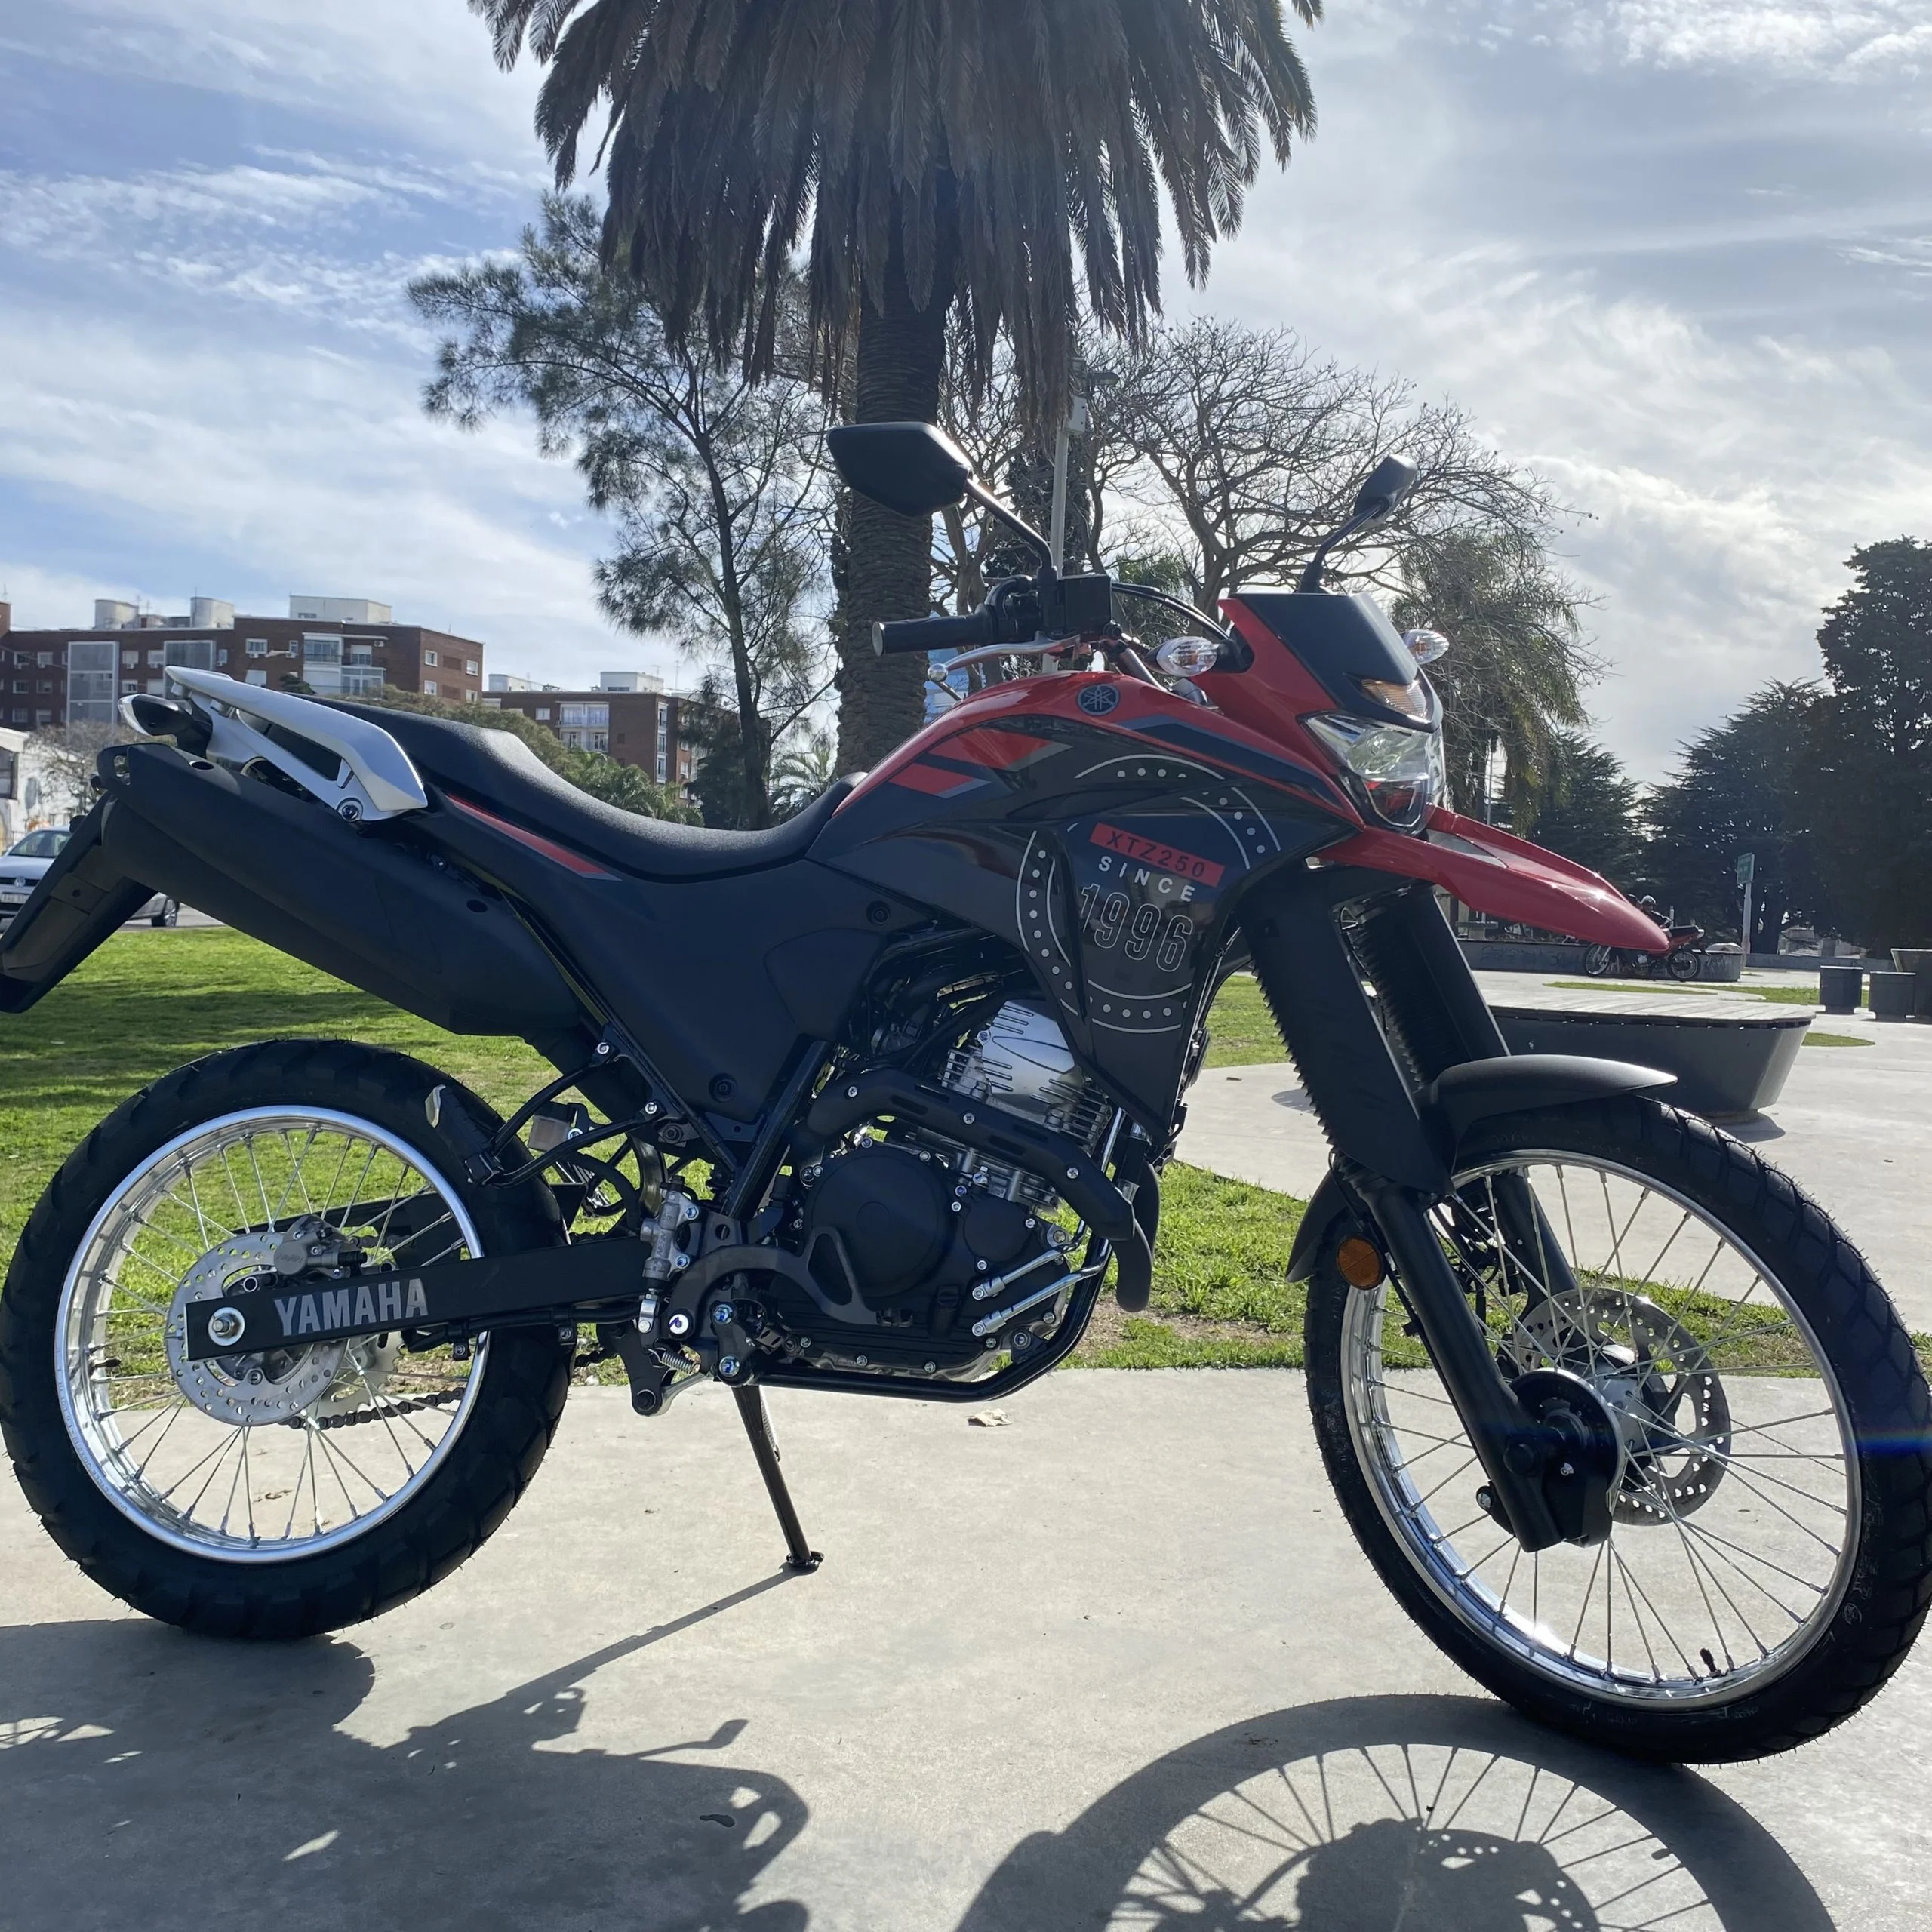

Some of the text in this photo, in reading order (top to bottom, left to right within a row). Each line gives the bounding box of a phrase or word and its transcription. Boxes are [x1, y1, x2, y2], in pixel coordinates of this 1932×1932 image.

[1098, 856, 1195, 902] SINCE
[1106, 830, 1205, 878] XTZ250
[1081, 884, 1193, 972] 1996
[274, 1278, 429, 1337] YAMAHA
